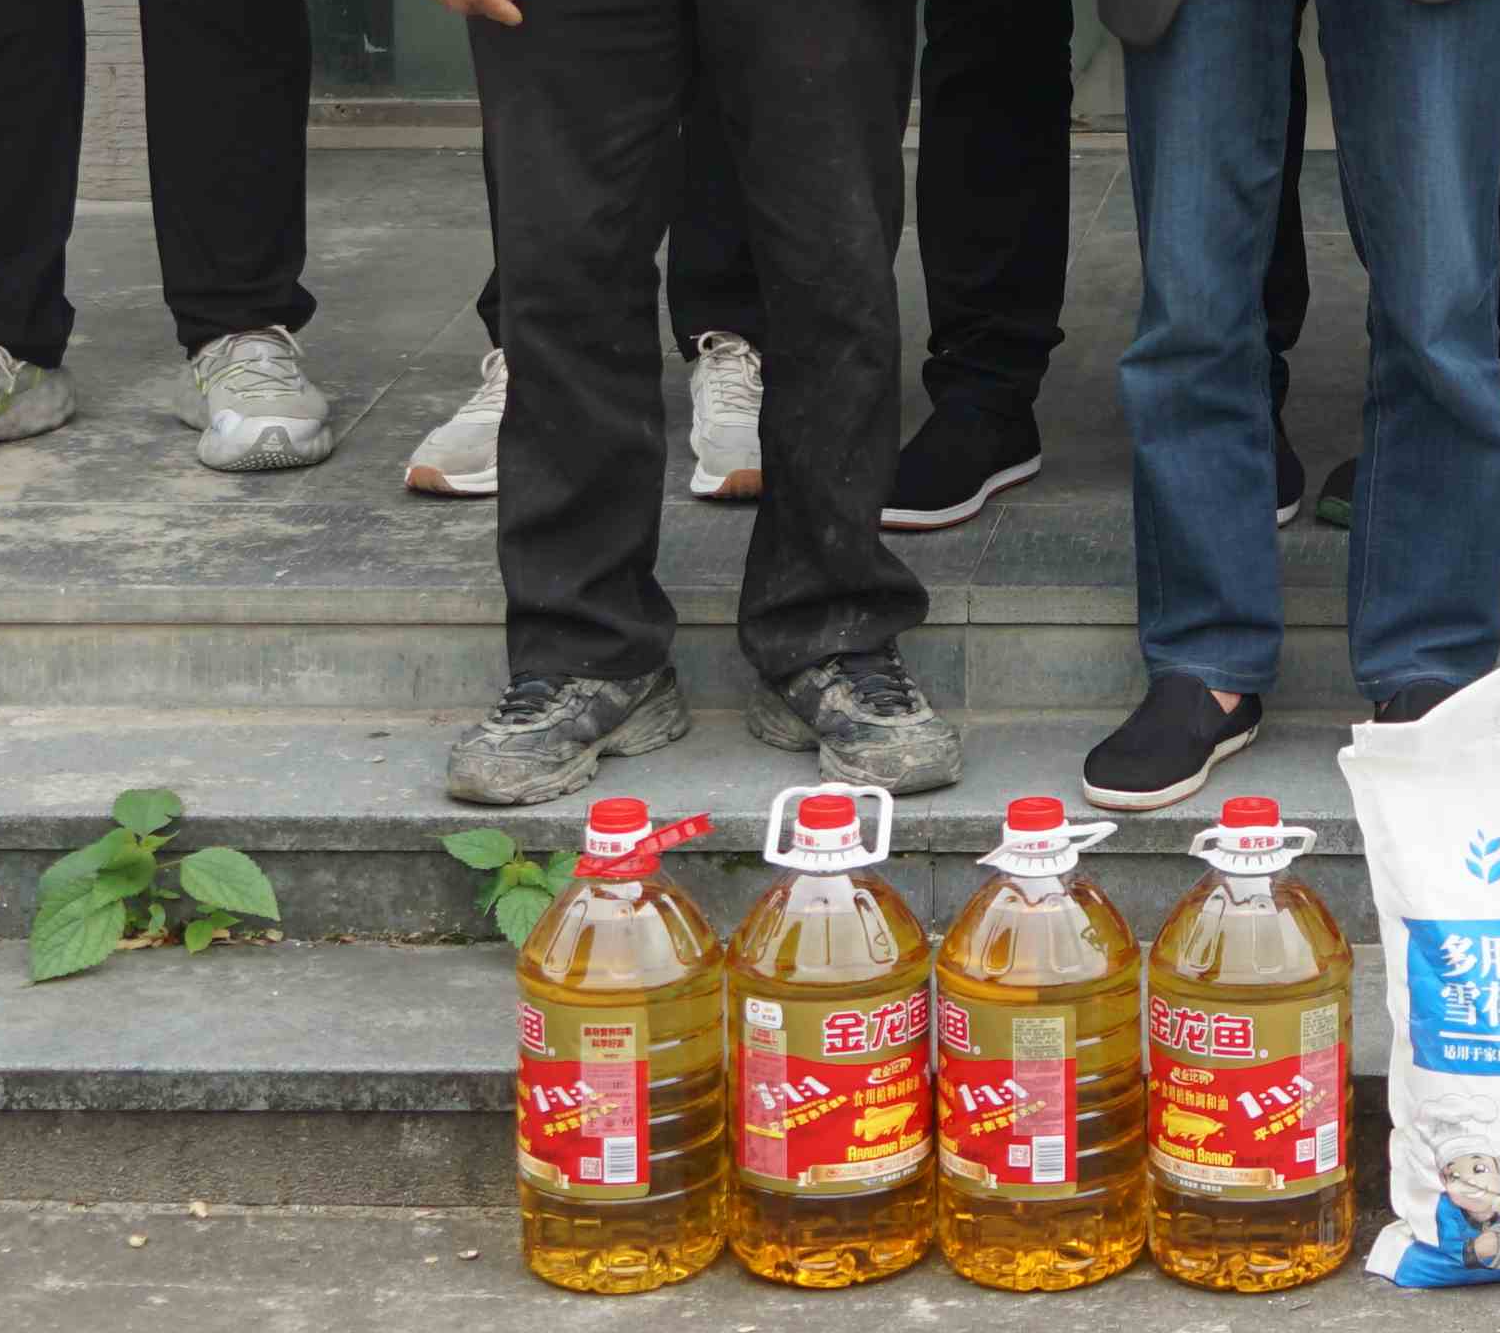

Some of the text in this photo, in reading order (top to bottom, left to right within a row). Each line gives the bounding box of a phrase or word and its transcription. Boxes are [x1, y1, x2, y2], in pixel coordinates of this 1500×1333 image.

[823, 989, 930, 1056] 金龙鱼
[1150, 996, 1255, 1059] 金龙鱼
[958, 1079, 1030, 1112] 1:1:1
[1236, 1075, 1315, 1119] 1:1:1
